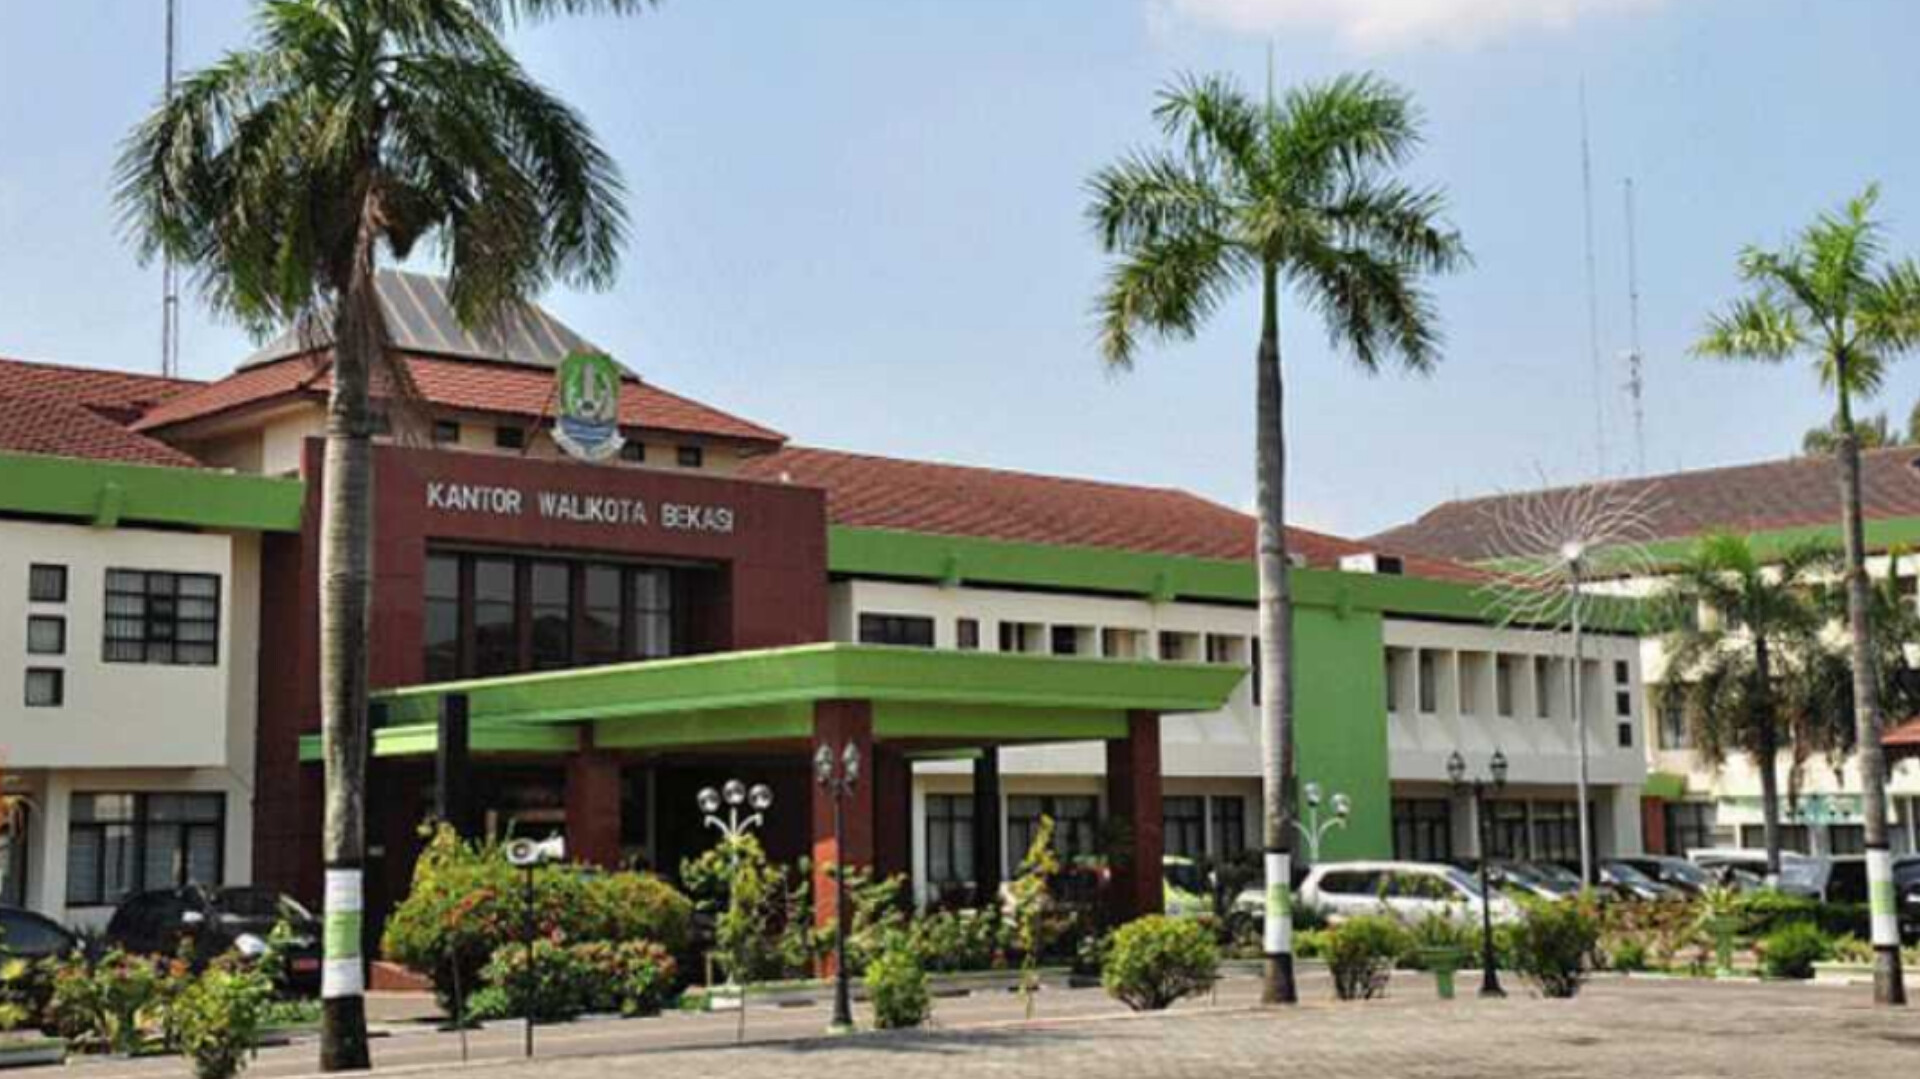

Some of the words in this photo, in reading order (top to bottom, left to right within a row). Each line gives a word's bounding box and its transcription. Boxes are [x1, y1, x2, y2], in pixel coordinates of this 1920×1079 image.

[426, 482, 521, 513] KANTOR
[539, 491, 647, 525] WALIKOTA
[661, 503, 734, 533] BEKASI
